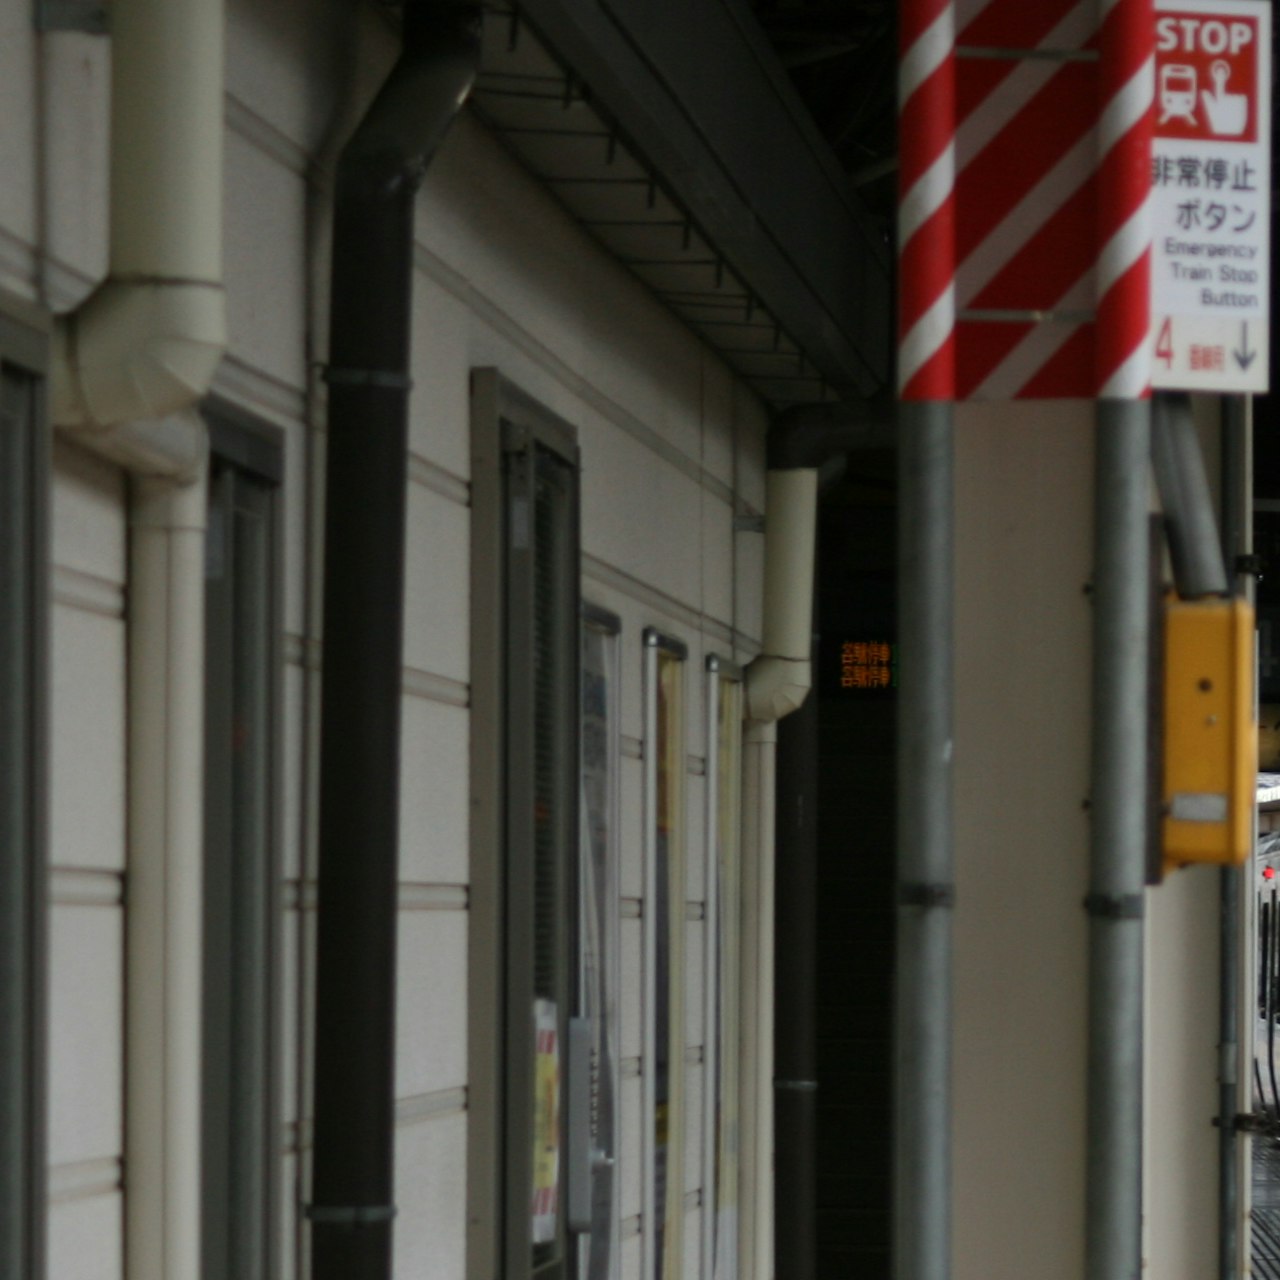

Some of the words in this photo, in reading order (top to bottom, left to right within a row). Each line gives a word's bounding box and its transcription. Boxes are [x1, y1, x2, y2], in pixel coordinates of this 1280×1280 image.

[1156, 17, 1253, 55] STOP
[1152, 157, 1257, 190] 非常停止
[1176, 199, 1257, 232] ボタン
[1164, 237, 1257, 259] Emergency
[1170, 261, 1213, 281] Train
[1219, 263, 1258, 284] Stop
[1201, 288, 1259, 308] Button
